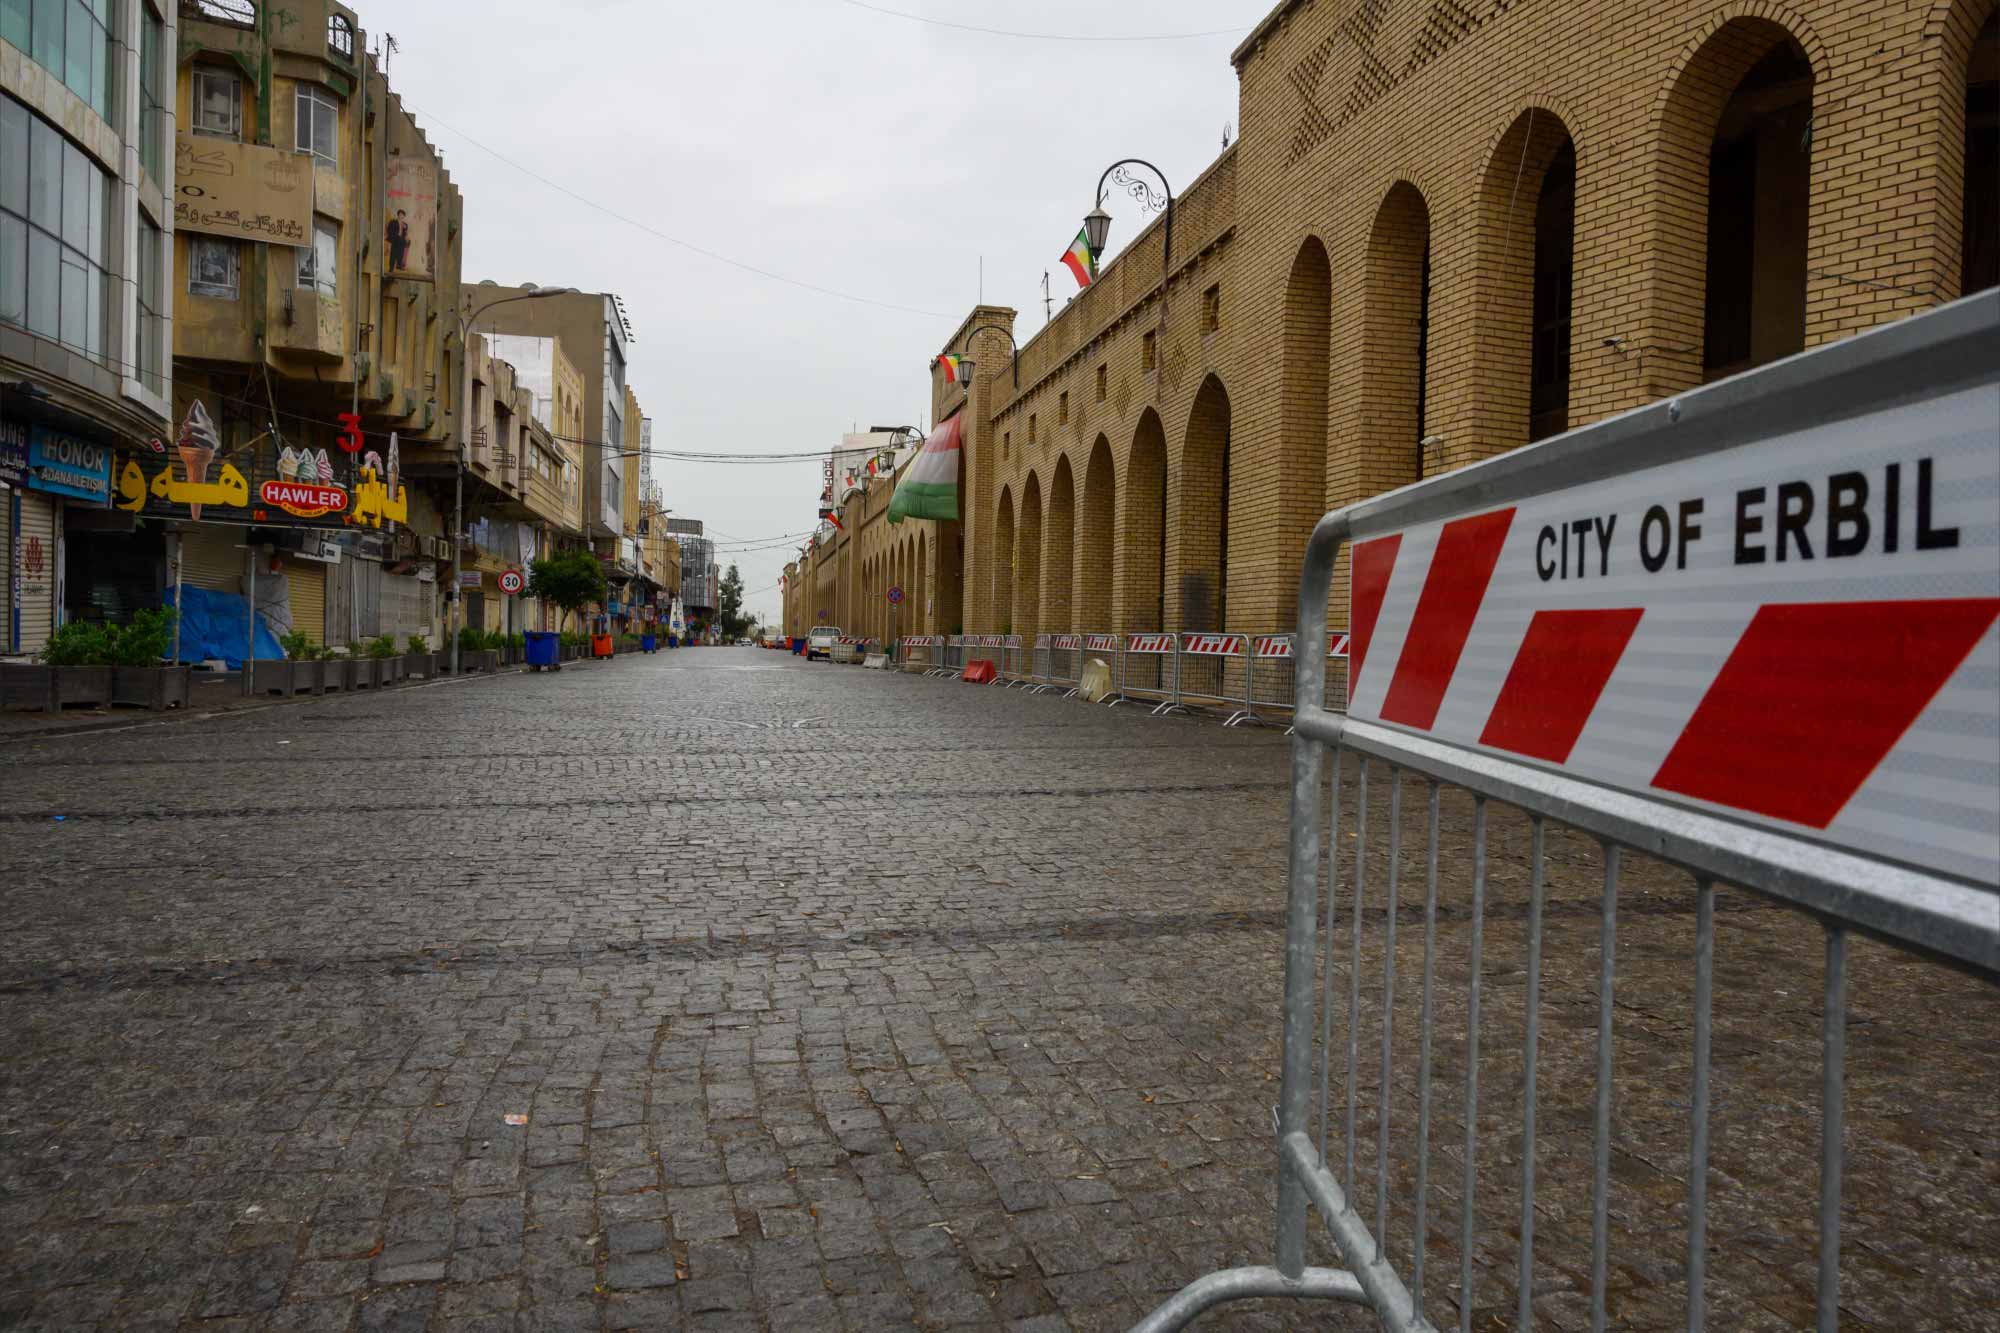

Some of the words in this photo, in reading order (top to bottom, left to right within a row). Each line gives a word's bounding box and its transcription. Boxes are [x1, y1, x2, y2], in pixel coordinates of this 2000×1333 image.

[336, 412, 365, 453] 3
[42, 435, 104, 472] HONOR
[266, 485, 343, 508] HAWLER
[1535, 513, 1618, 582] CITY
[1639, 497, 1705, 573] OF
[1733, 456, 1960, 566] ERBIL
[504, 576, 519, 588] 30
